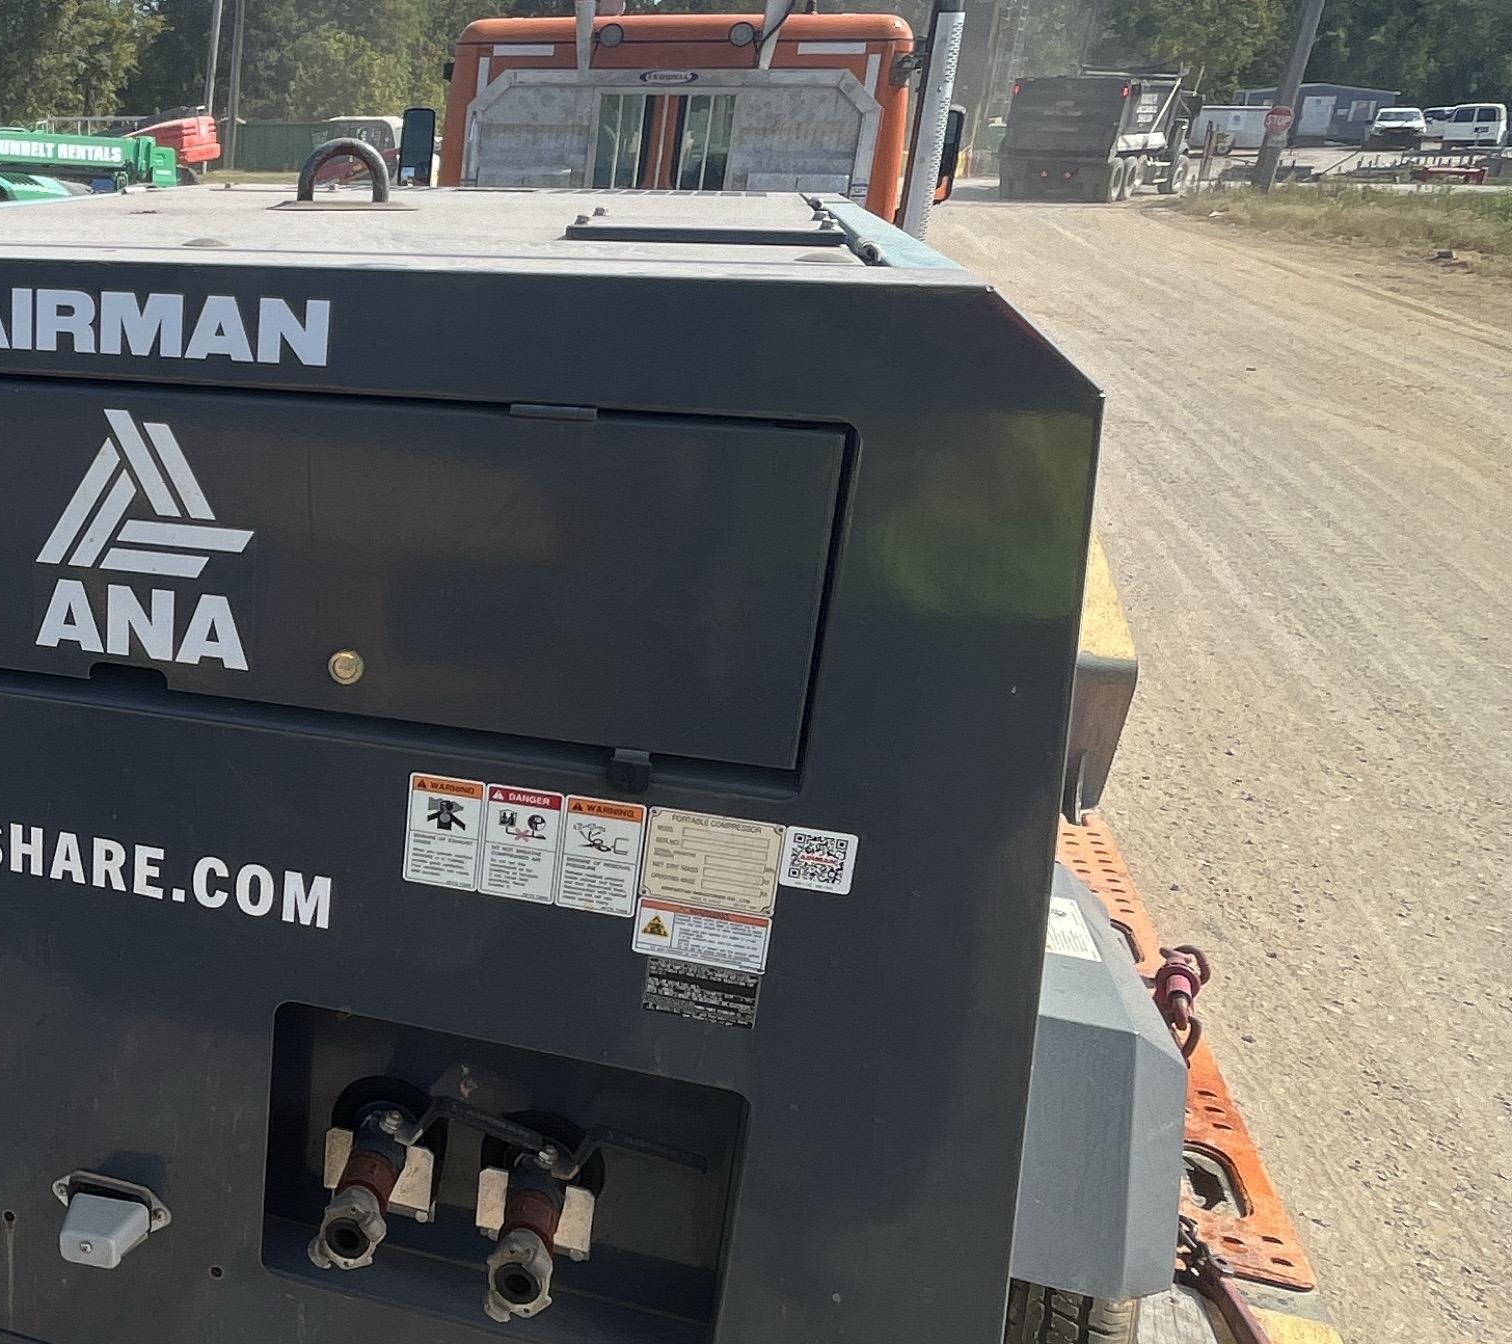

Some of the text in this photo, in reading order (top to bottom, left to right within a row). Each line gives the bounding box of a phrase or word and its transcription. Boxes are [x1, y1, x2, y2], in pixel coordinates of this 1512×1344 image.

[1265, 114, 1292, 126] STOP
[57, 143, 122, 162] RENTALS
[35, 578, 249, 671] ANA
[430, 782, 475, 795] WARNING
[508, 793, 551, 806] DANGER
[587, 804, 634, 817] WARNING
